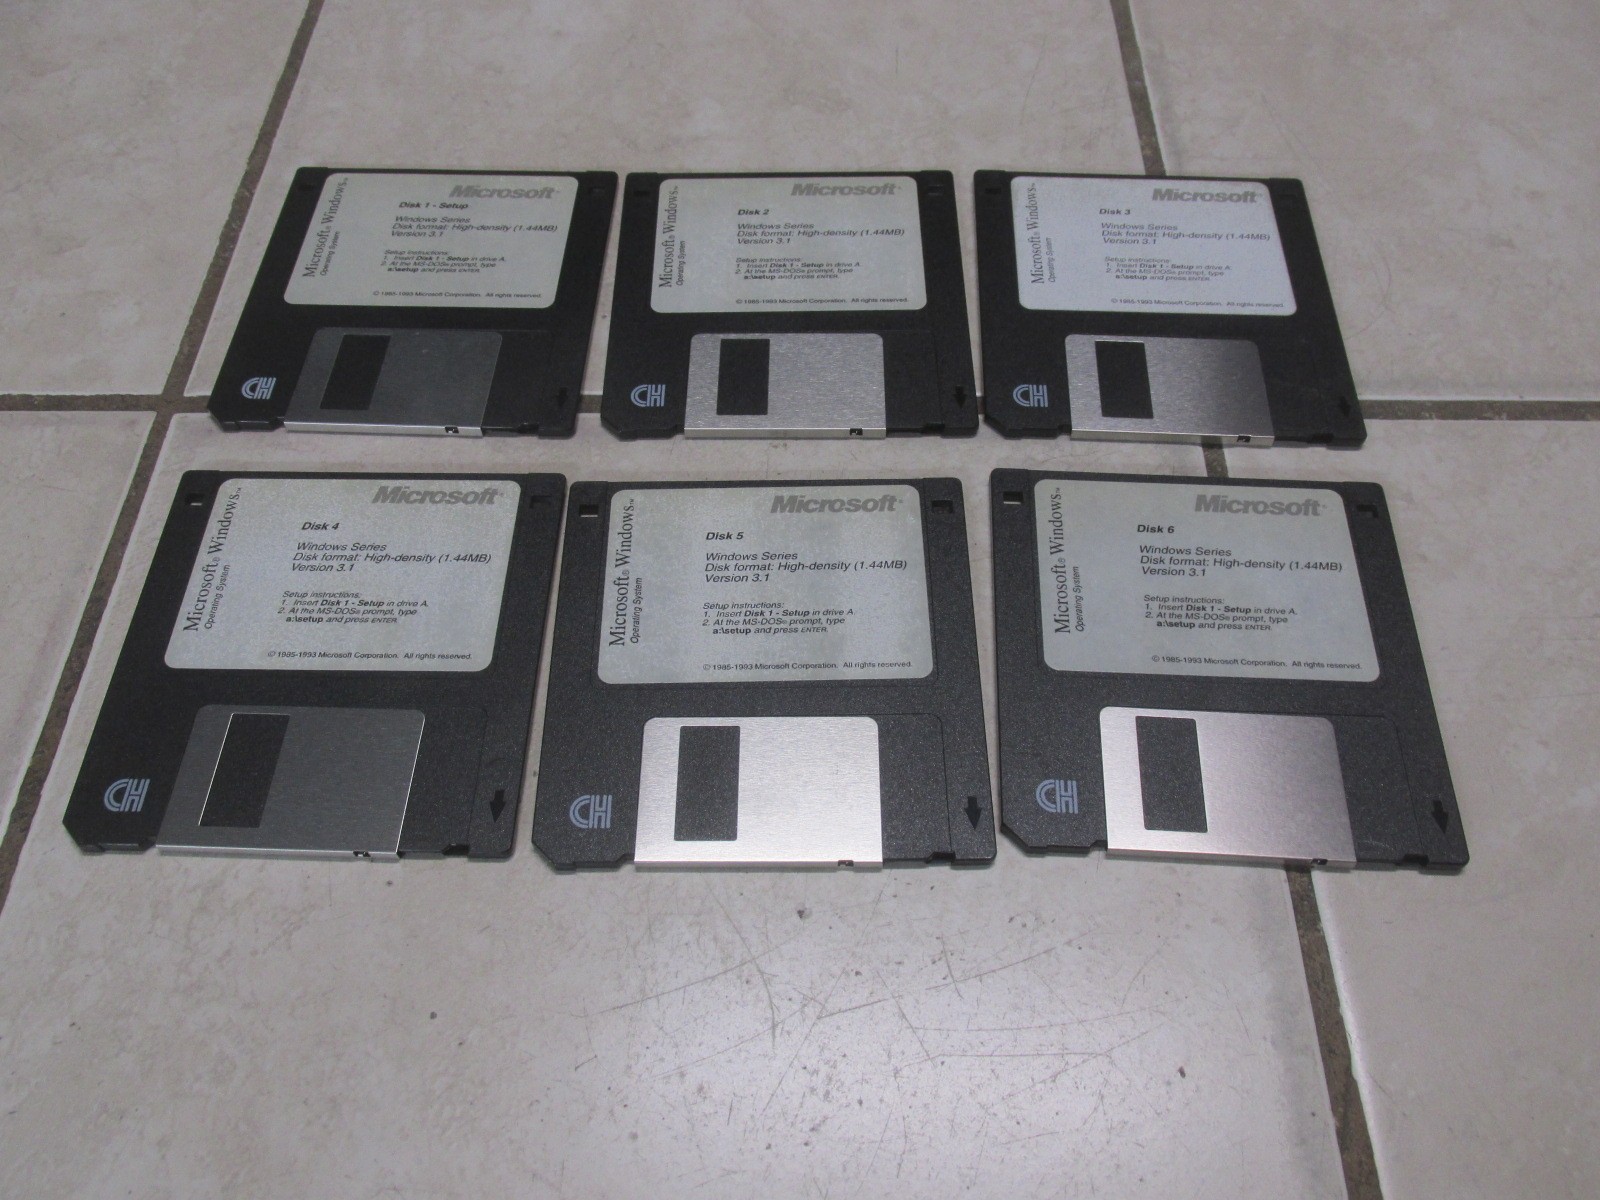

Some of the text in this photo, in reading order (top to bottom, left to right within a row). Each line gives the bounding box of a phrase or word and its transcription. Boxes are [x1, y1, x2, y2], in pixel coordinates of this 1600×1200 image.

[398, 202, 423, 210] Disk
[438, 202, 468, 210] Setup
[451, 224, 511, 232] High-density
[797, 229, 858, 237] High-density
[860, 228, 905, 236] (1.44MB)
[1162, 231, 1223, 240] High-density
[1226, 233, 1270, 241] (1.44MB)
[301, 521, 340, 530] Disk 4
[1137, 524, 1174, 534] Disk 6
[706, 531, 744, 540] Disk 5
[297, 542, 387, 551] Windows Series
[1139, 545, 1231, 557] Windows Series
[292, 552, 492, 564] Disk format: High-density (1.44MB)
[706, 551, 798, 561] Windows Series
[292, 563, 354, 572] Version 3.1
[704, 560, 908, 572] Disk format: High-density (1.44MB)
[1140, 555, 1341, 573] Disk format: High-density (1.44MB)
[1142, 566, 1205, 577] Version 3.1
[705, 573, 769, 582] Version 3.1
[204, 564, 230, 629] Operating System
[1072, 566, 1085, 632] Operating System
[356, 599, 385, 608] Setup
[702, 602, 729, 610] Setup
[629, 577, 643, 644] Operating System
[781, 609, 810, 617] Setup
[789, 617, 823, 626] prompt,
[826, 617, 845, 625] type
[1232, 615, 1266, 623] prompt,
[1268, 616, 1288, 624] type
[753, 626, 772, 634] and
[772, 627, 798, 635] press
[854, 661, 876, 669] rights
[1162, 656, 1203, 664] 1985-1993
[1204, 657, 1239, 665] Microsoft
[1240, 659, 1287, 667] Corporation.
[1303, 661, 1325, 669] rights
